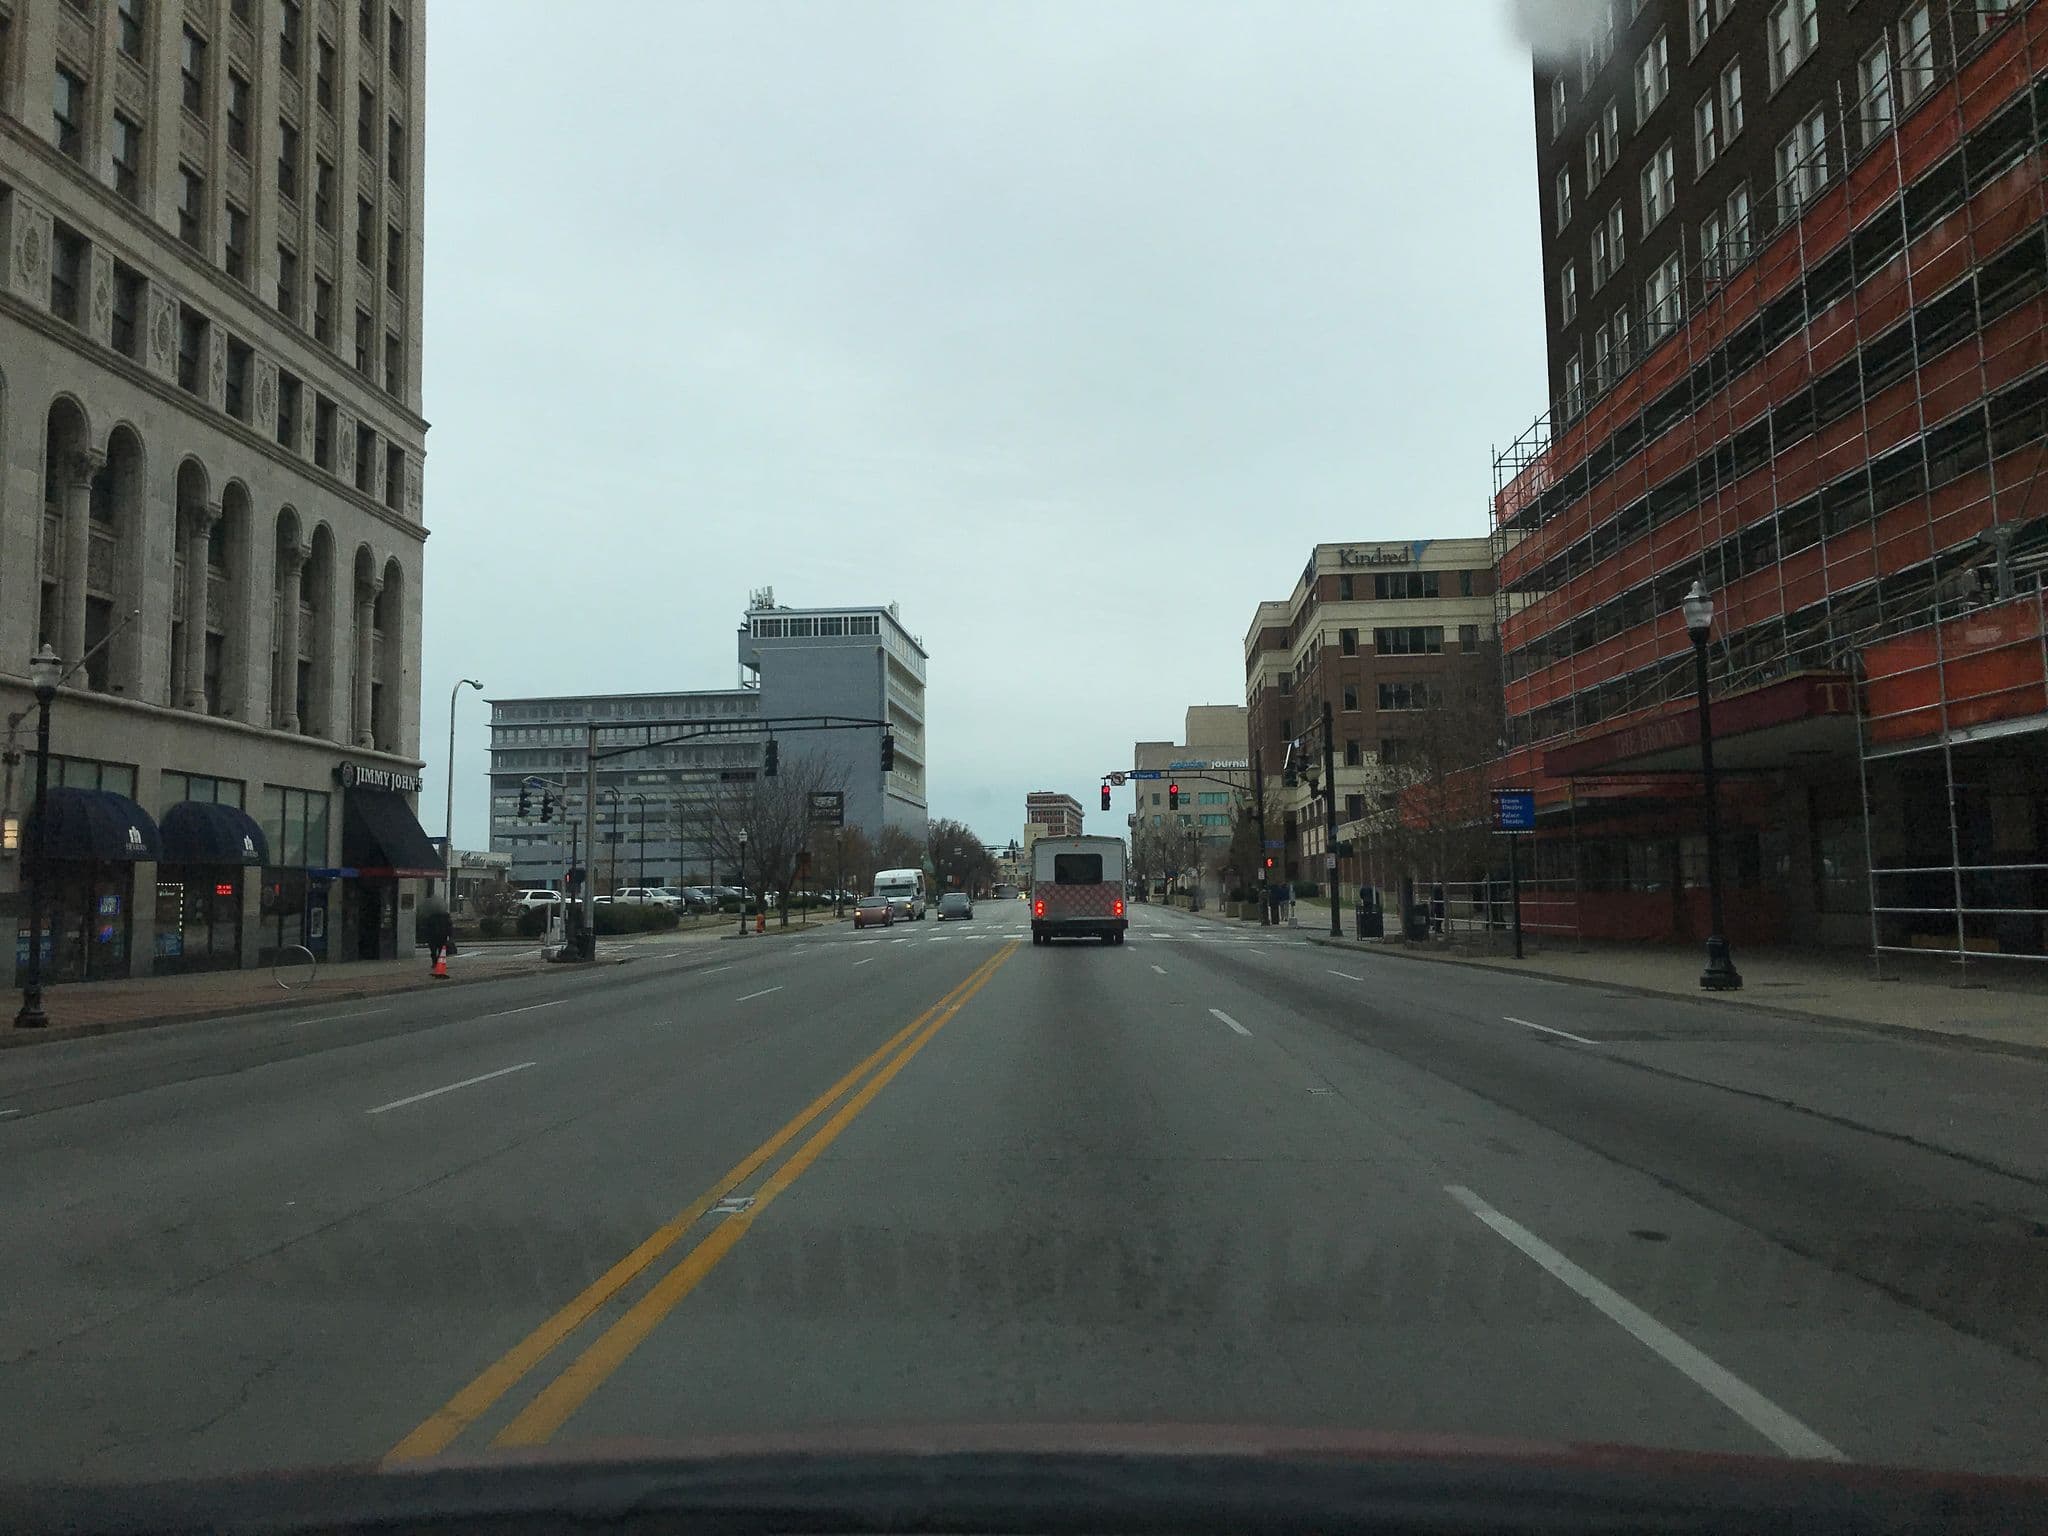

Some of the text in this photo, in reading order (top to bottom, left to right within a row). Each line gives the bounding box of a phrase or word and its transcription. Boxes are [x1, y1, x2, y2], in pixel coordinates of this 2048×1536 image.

[1338, 546, 1410, 566] Kindred
[1210, 759, 1249, 770] journal
[356, 766, 423, 792] JIMMY JOHN'S
